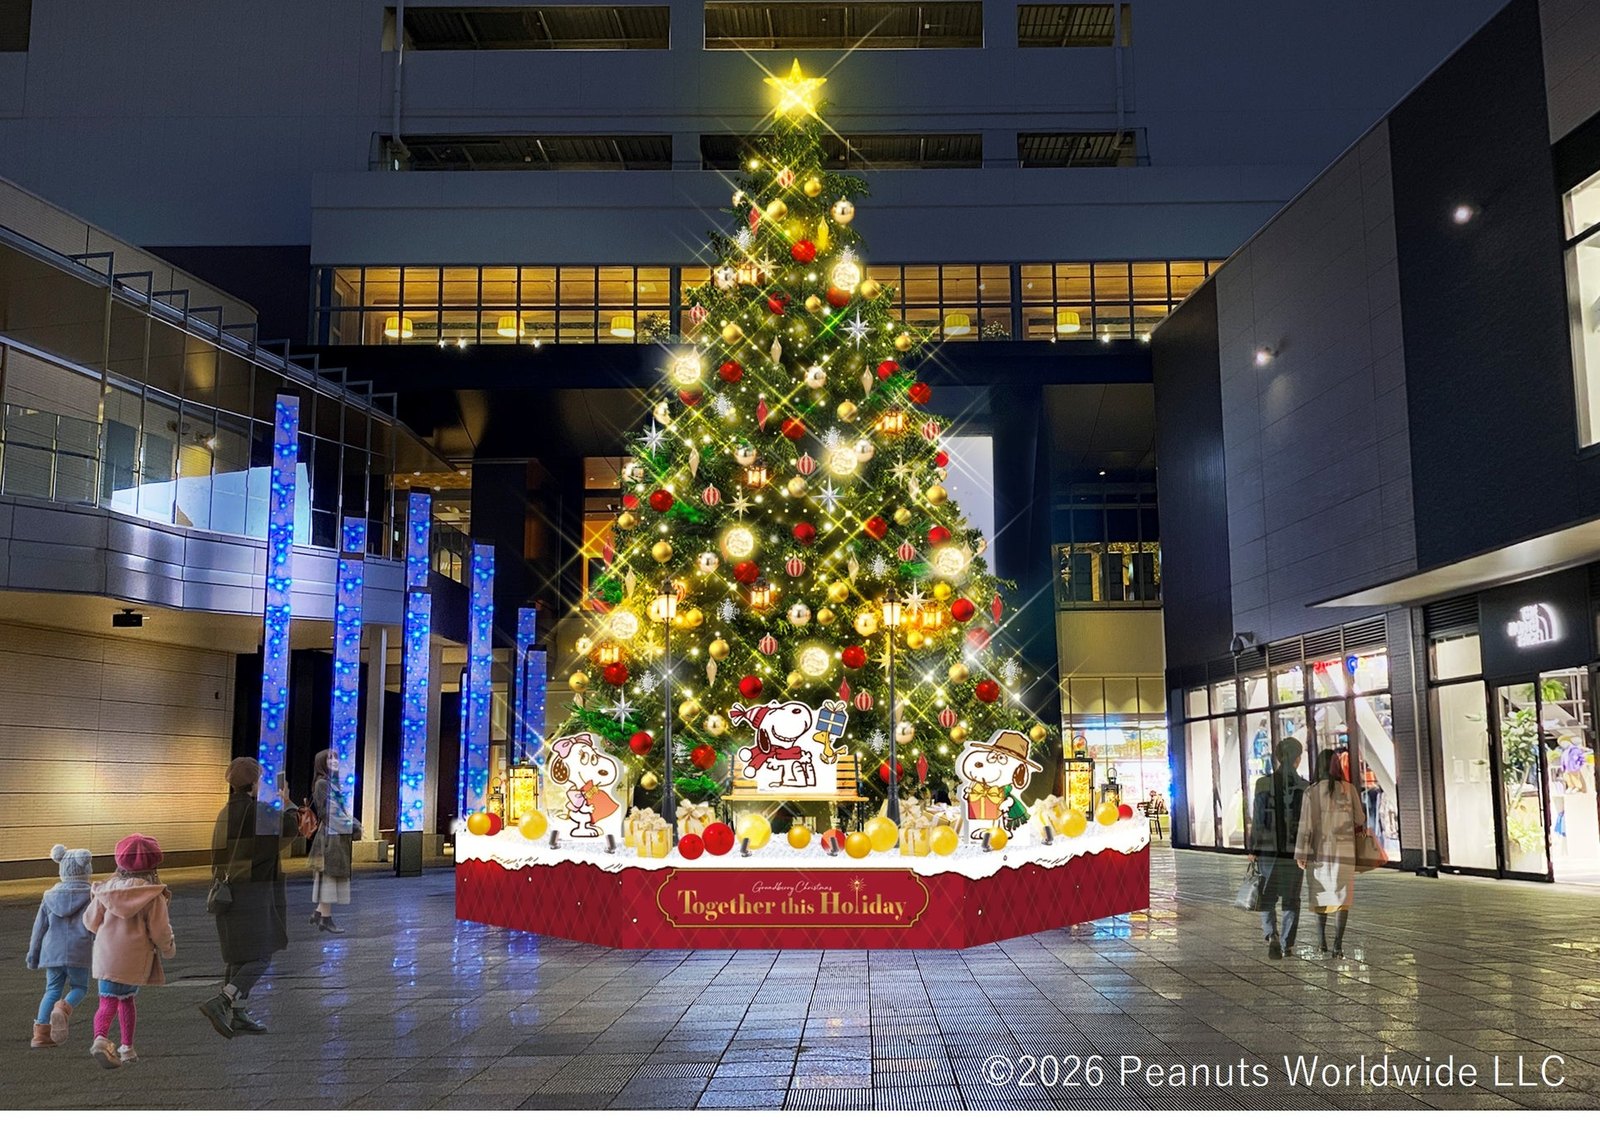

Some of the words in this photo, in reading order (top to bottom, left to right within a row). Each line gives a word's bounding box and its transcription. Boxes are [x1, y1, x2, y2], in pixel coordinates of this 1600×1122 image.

[795, 880, 832, 893] Christmas
[677, 889, 776, 921] Together
[780, 897, 815, 914] this
[820, 884, 907, 920] Holiday
